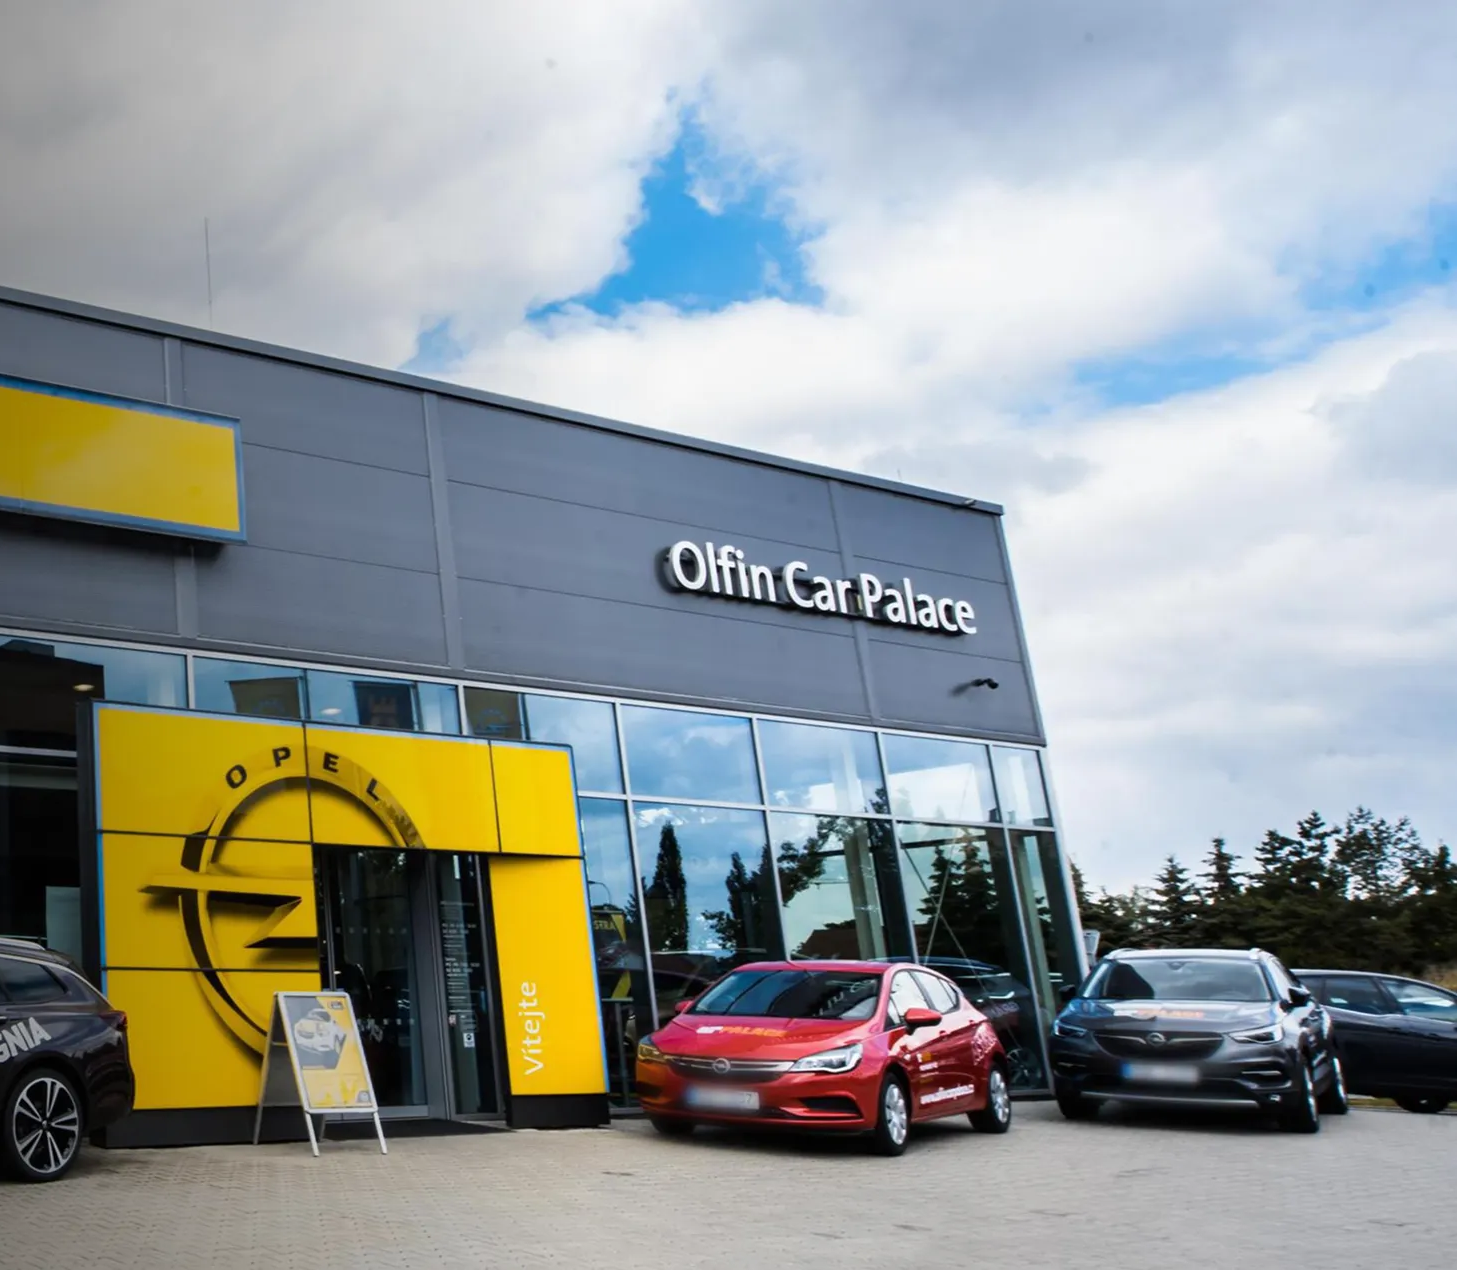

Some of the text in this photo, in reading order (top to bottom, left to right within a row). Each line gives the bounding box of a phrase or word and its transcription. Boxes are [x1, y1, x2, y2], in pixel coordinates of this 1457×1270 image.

[668, 541, 977, 635] Olfin Car Palace
[225, 746, 381, 801] OPEL
[593, 919, 617, 931] STRA
[519, 981, 545, 1075] Vítejte
